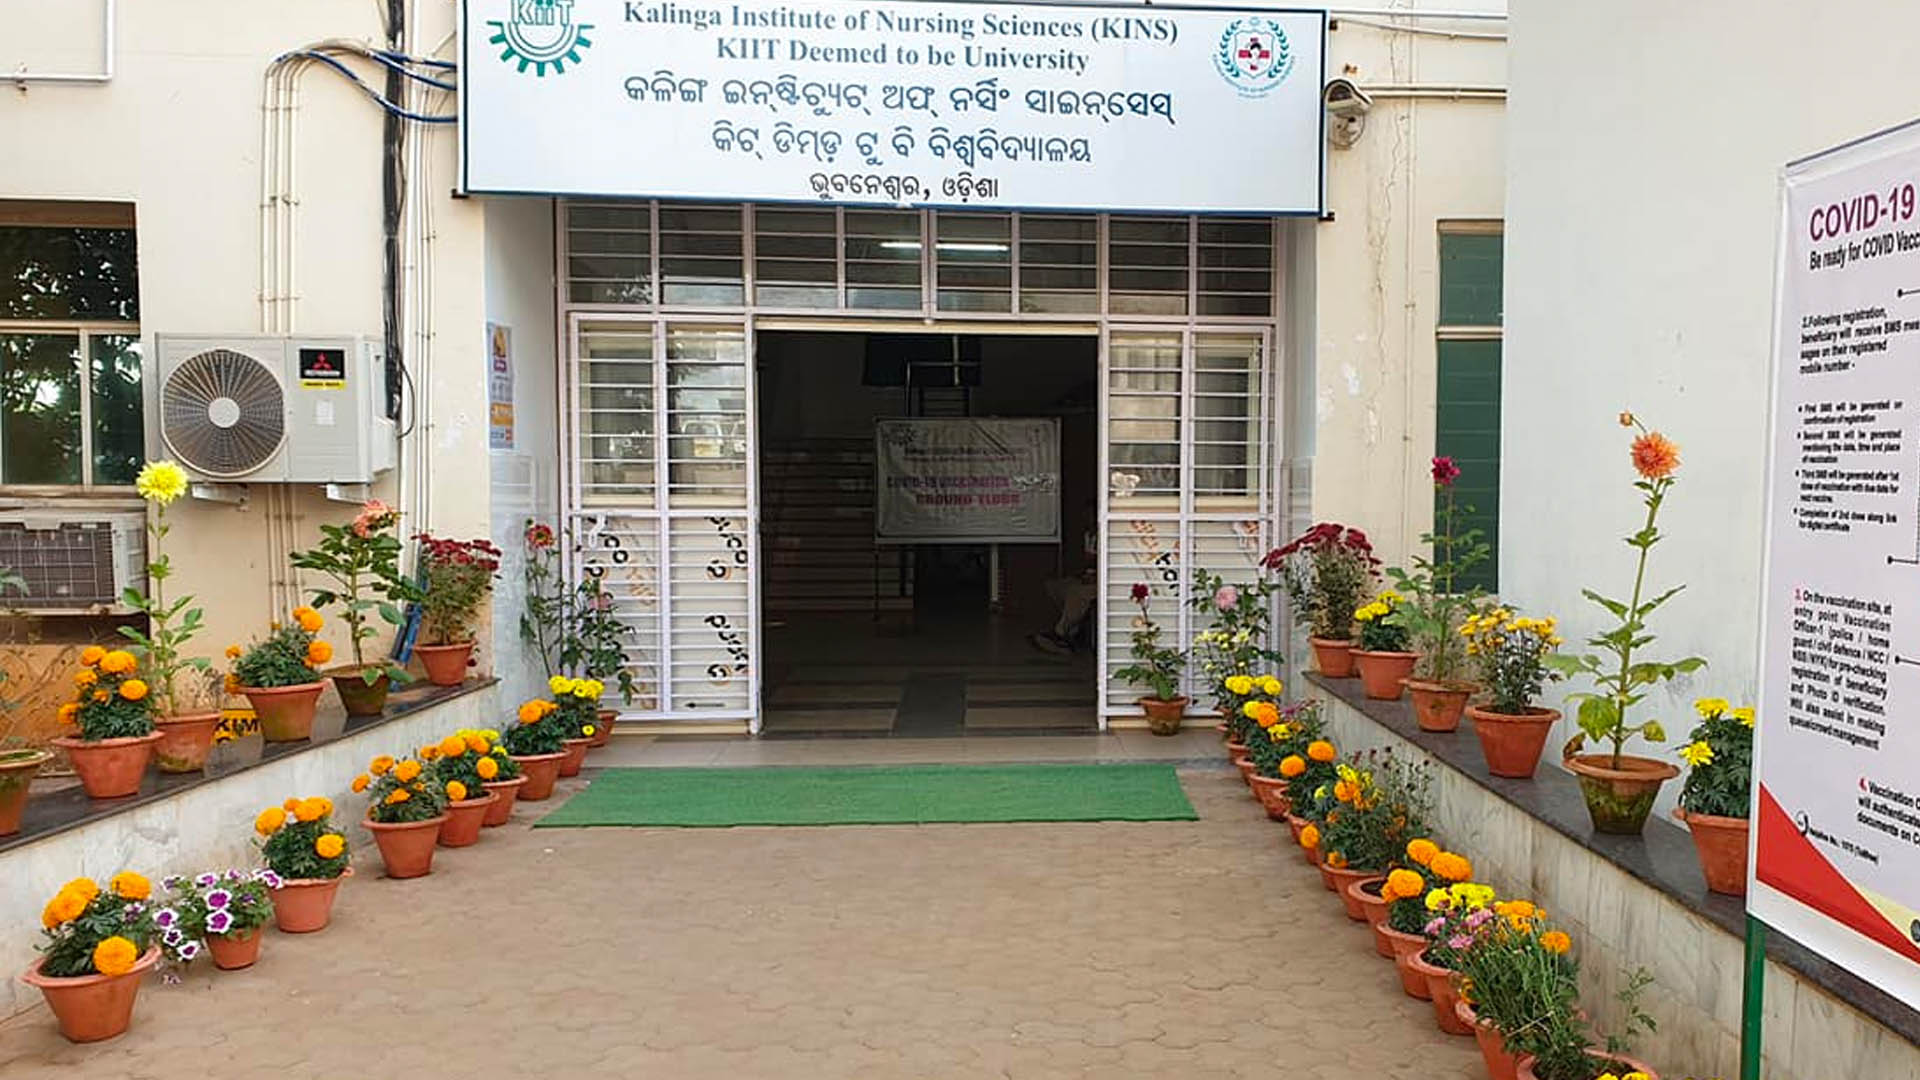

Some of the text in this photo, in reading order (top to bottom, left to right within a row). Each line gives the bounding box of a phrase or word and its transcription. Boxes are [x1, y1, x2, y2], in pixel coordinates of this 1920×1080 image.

[624, 2, 1178, 44] Kalinga Institute of Nursing Sciences (KINS)
[716, 37, 1089, 76] KIIT Deemed to be University
[624, 70, 708, 102] କଳିଙ୍ଗ
[882, 85, 938, 117] ଅଫ୍
[712, 119, 763, 160] କିଟ୍
[856, 131, 883, 165] ଟୁ
[891, 125, 915, 157] ବି
[1809, 184, 1915, 241] COVID-19
[1809, 251, 1821, 270] Be
[1823, 245, 1846, 269] ready
[1848, 241, 1861, 261] for
[1863, 233, 1895, 259] COVID
[1884, 320, 1901, 334] SMS
